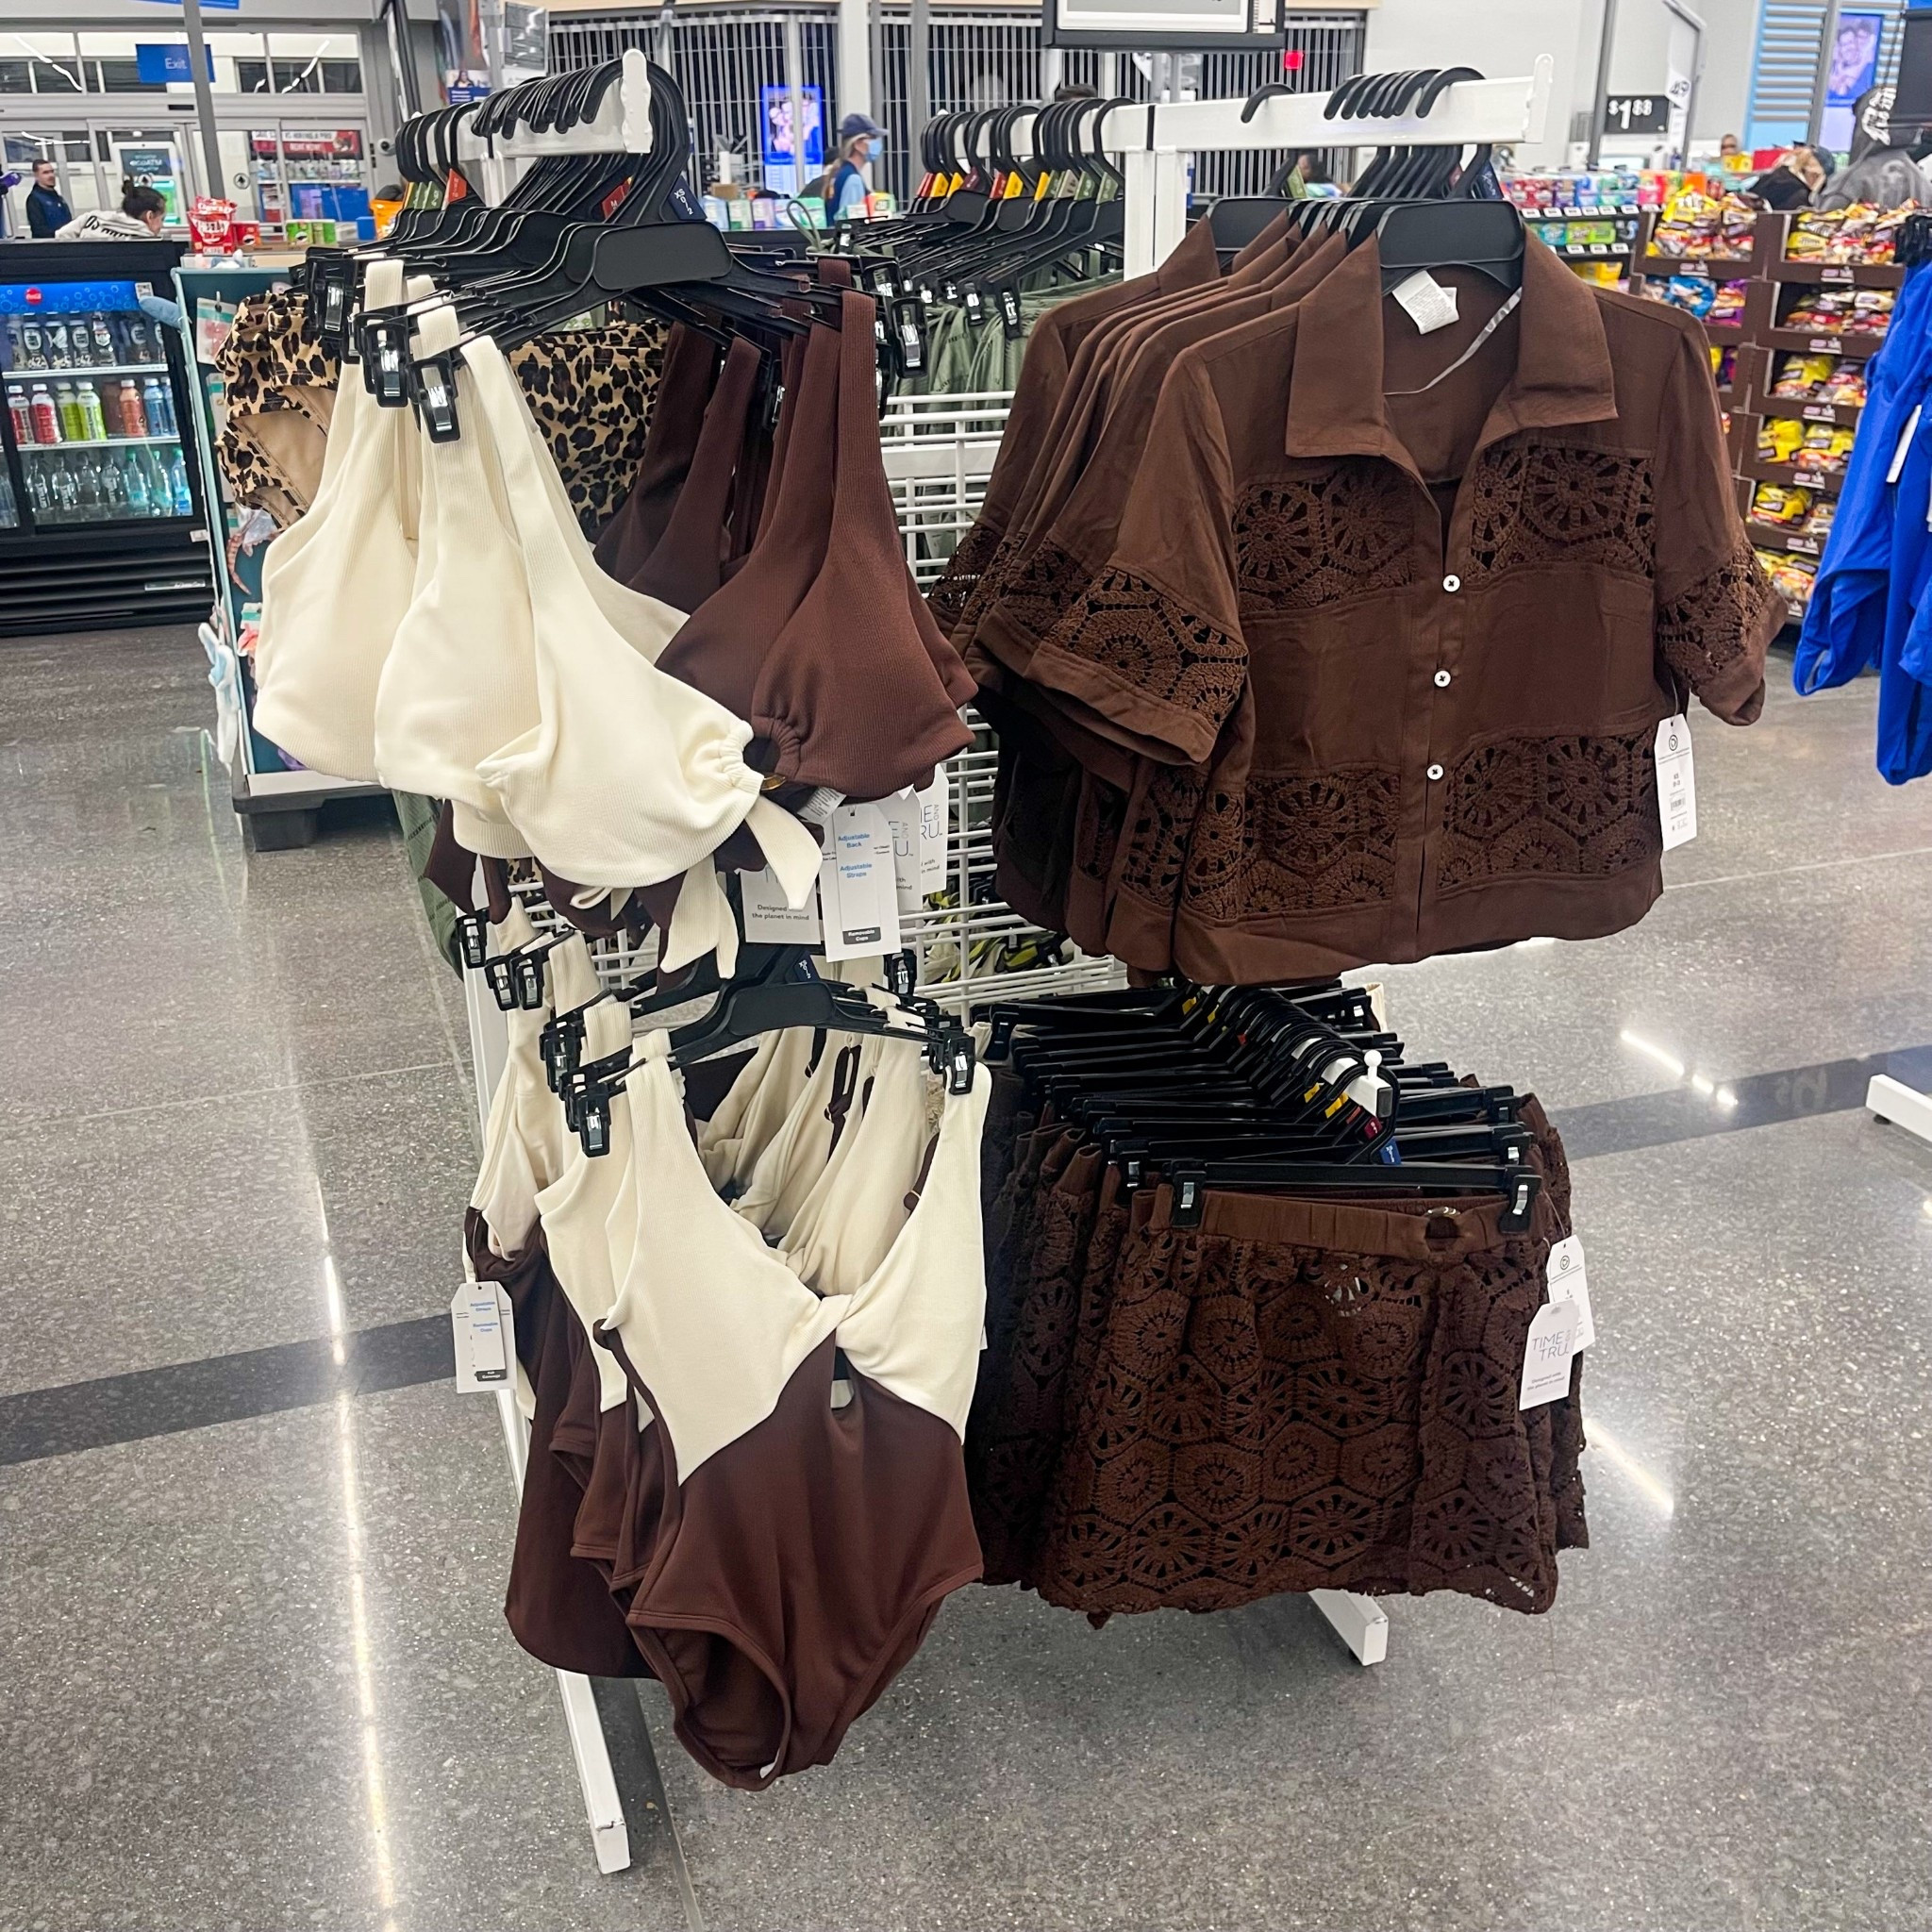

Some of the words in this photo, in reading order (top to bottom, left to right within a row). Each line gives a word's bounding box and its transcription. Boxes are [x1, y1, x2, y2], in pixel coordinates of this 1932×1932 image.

[165, 58, 188, 70] Exit
[838, 833, 870, 841] Adjustable
[840, 863, 873, 872] Adjustable
[1532, 1331, 1564, 1351] TIME
[1540, 1342, 1568, 1362] TRU
